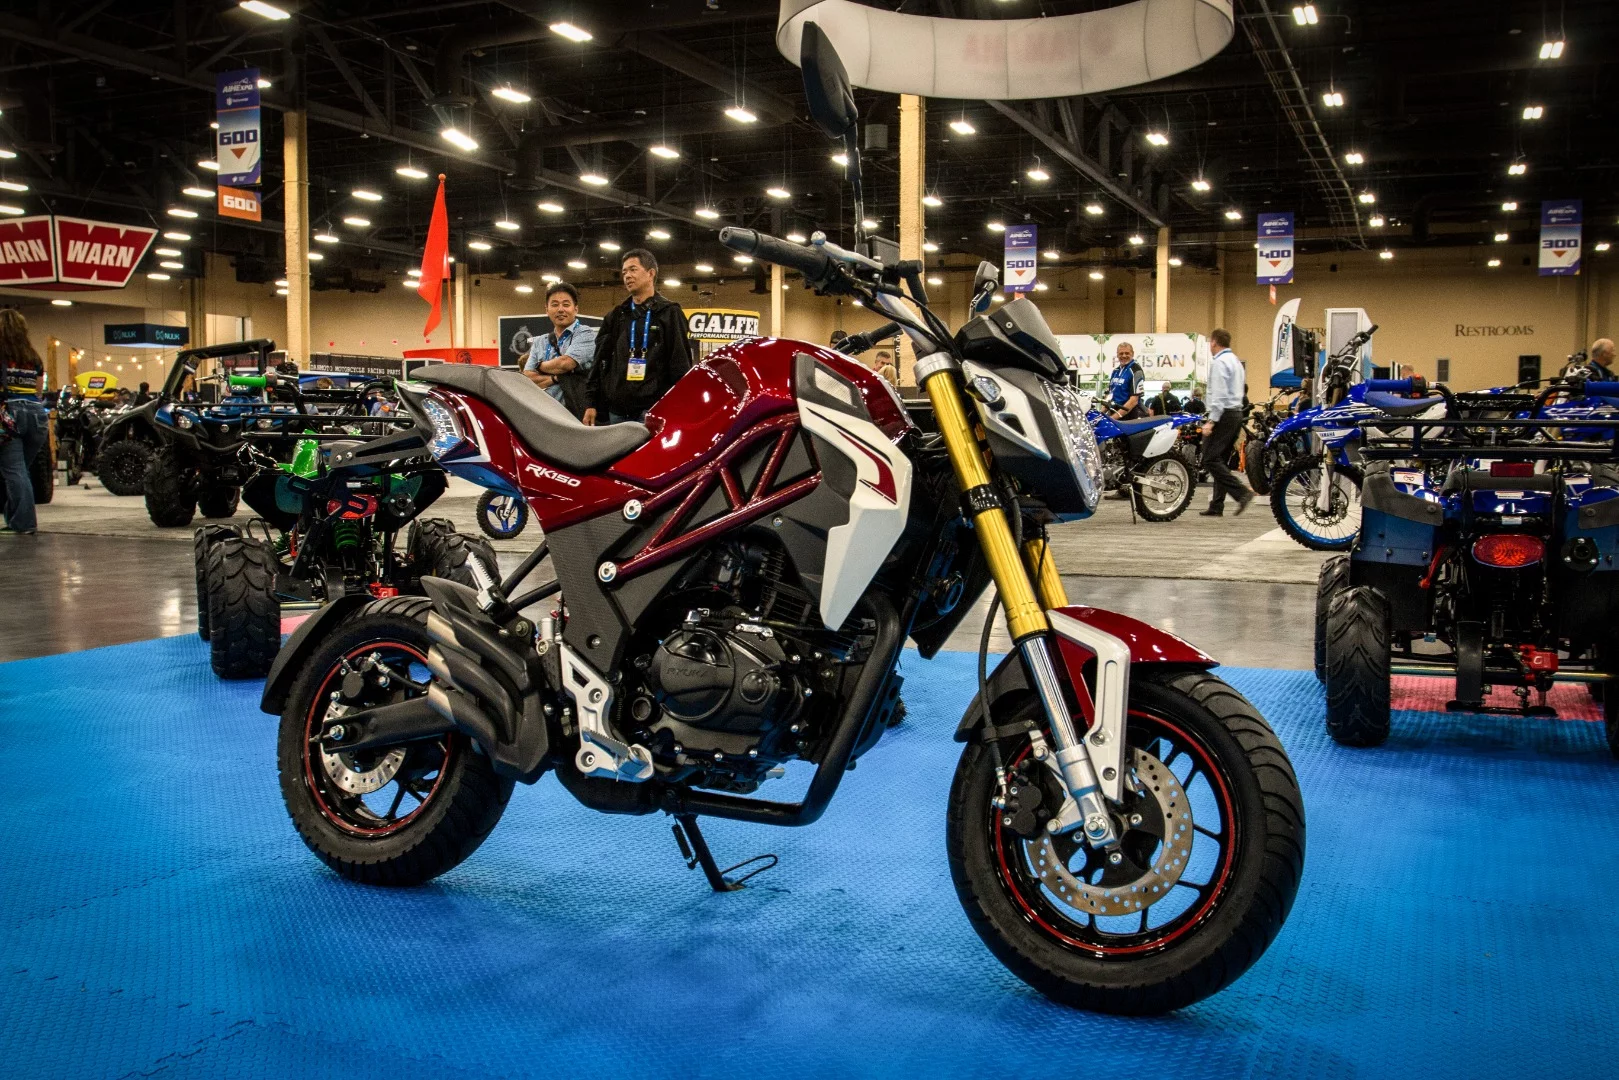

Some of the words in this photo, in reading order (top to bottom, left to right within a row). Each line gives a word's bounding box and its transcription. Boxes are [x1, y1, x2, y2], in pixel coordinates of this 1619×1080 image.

[219, 129, 258, 146] 600
[223, 194, 257, 213] 600
[1542, 238, 1578, 249] 300
[66, 239, 135, 268] WARN
[1259, 249, 1291, 259] 400
[1006, 259, 1035, 269] 500
[335, 365, 366, 374] MOTORCYCLE
[367, 367, 385, 375] RACING
[525, 463, 582, 488] RK150
